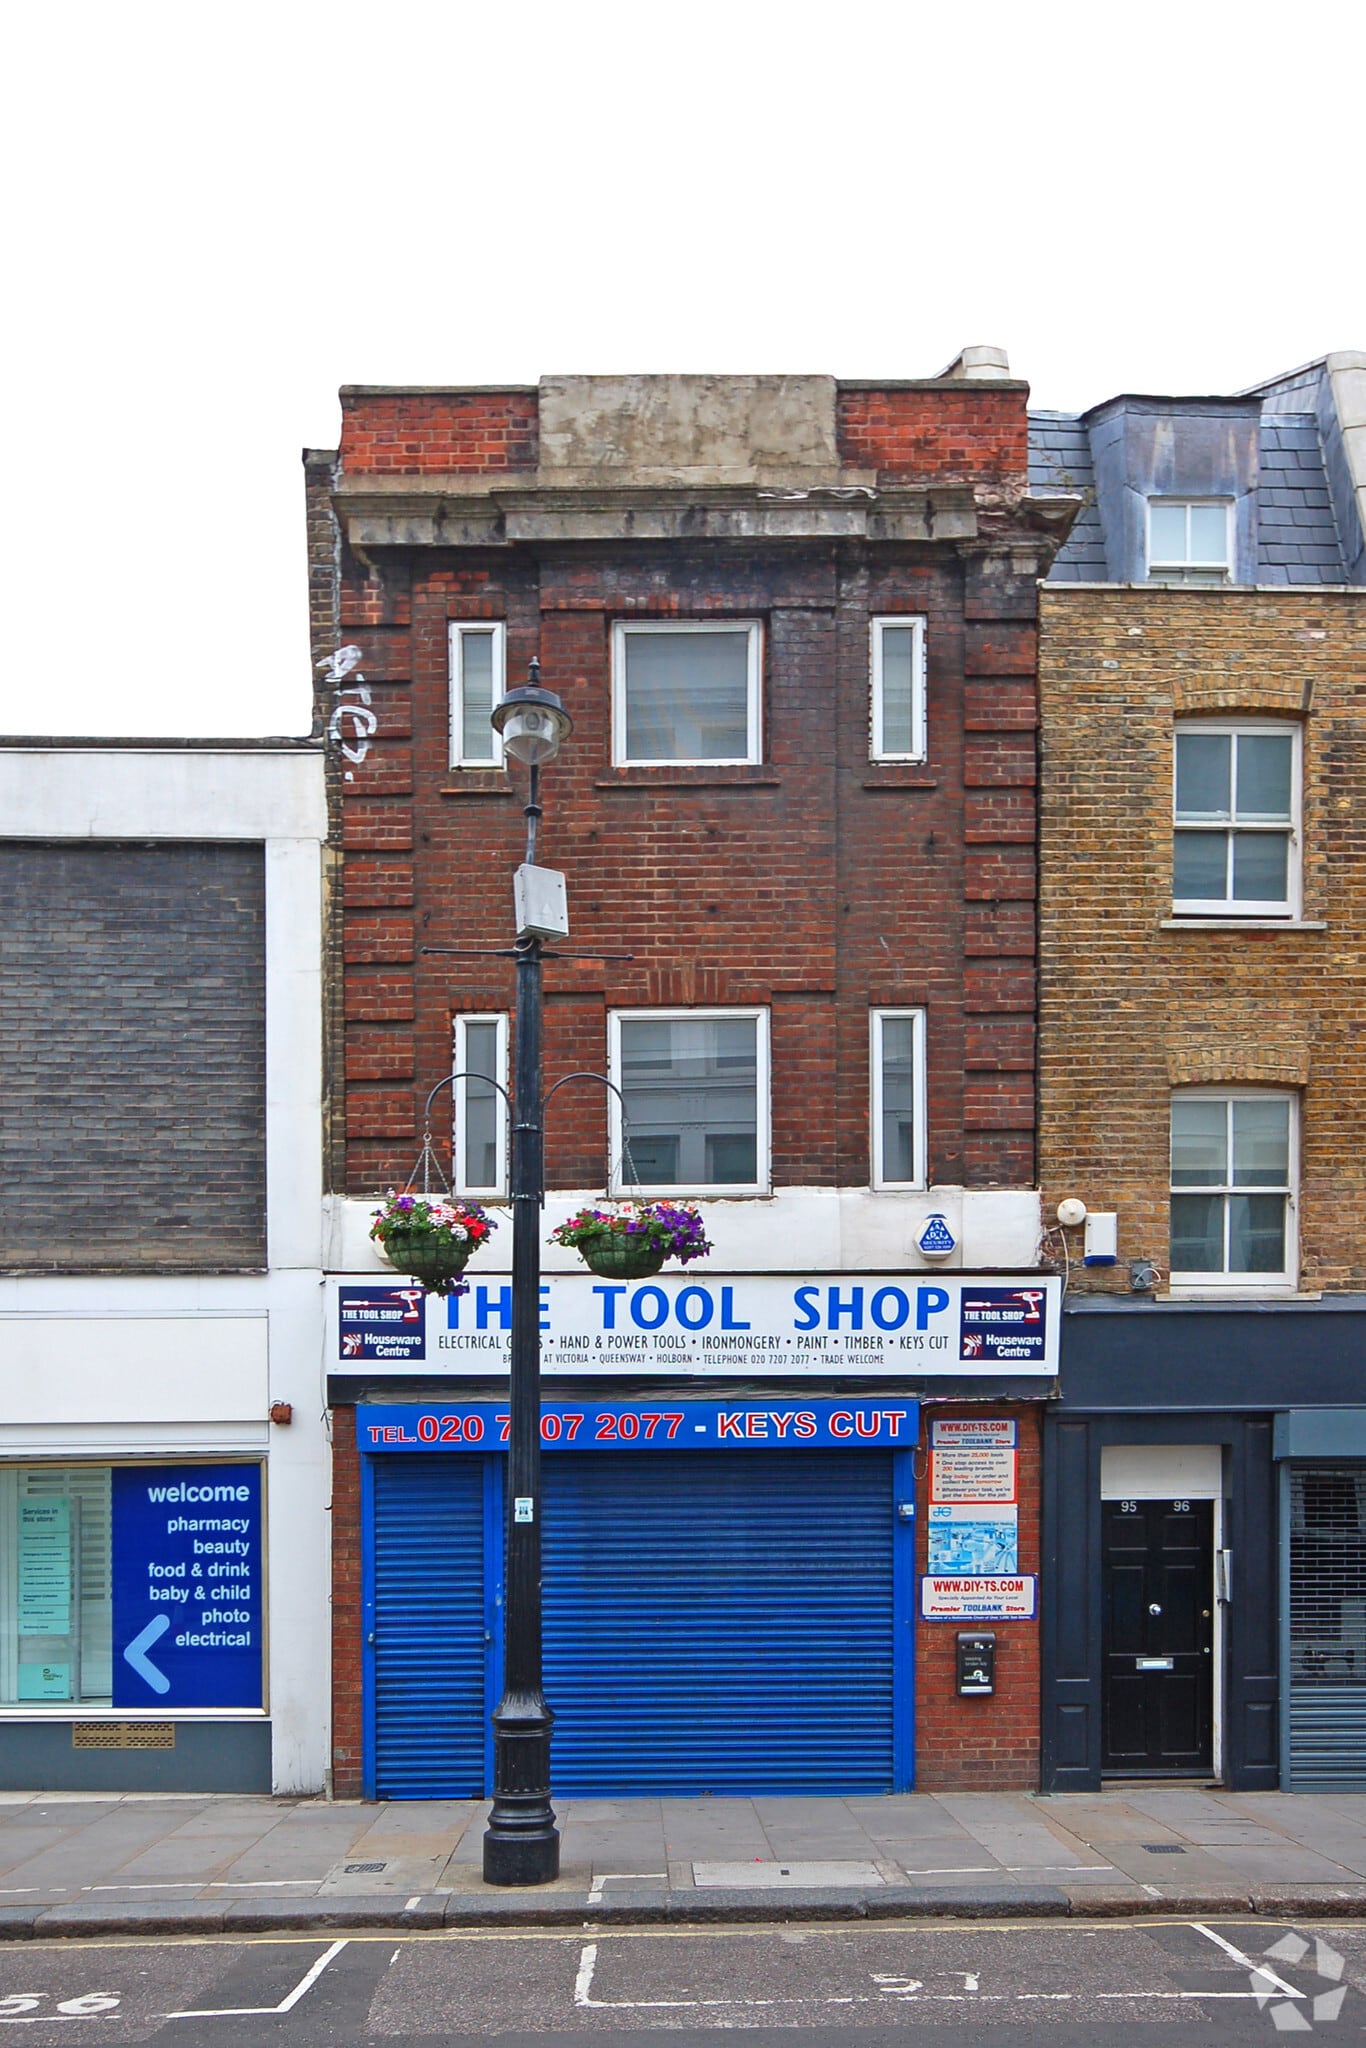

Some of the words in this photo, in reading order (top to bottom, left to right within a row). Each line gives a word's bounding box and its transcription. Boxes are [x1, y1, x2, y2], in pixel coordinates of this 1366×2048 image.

[592, 1285, 751, 1330] TOOL
[794, 1285, 950, 1331] SHOP
[342, 1310, 358, 1319] THE
[360, 1310, 379, 1319] TOOL
[380, 1310, 403, 1320] SHOP
[964, 1311, 980, 1320] THE
[981, 1311, 1000, 1320] TOOL
[1002, 1311, 1025, 1321] SHOP
[364, 1333, 422, 1345] Houseware
[438, 1335, 502, 1349] ELECTRICAL
[560, 1335, 590, 1349] HAND
[595, 1335, 602, 1349] &
[608, 1335, 648, 1349] POWER
[652, 1335, 687, 1349] TOOLS
[702, 1335, 781, 1349] IRONMONGERY
[797, 1336, 828, 1349] PAINT
[844, 1336, 884, 1349] TIMBER
[900, 1336, 924, 1349] KEYS
[929, 1336, 949, 1349] CUT
[986, 1334, 1042, 1345] Houseware
[375, 1345, 410, 1356] Centre
[996, 1346, 1031, 1357] Centre
[544, 1354, 553, 1363] AT
[555, 1354, 588, 1363] VICTORIA
[599, 1354, 646, 1363] QUEENSWAY
[656, 1354, 693, 1363] HOLBORN
[704, 1354, 747, 1364] TELEPHONE
[750, 1354, 766, 1364] 020
[769, 1354, 787, 1364] 7207
[791, 1354, 809, 1364] 2077
[820, 1354, 844, 1364] TRADE
[848, 1354, 884, 1364] WELCOME
[367, 1426, 417, 1443] TEL.
[417, 1415, 484, 1442] 020
[495, 1413, 584, 1441] 707
[595, 1413, 684, 1440] 2077
[717, 1411, 817, 1439] KEYS
[828, 1411, 907, 1438] CUT
[147, 1482, 250, 1503] welcome
[1121, 1501, 1137, 1513] 95
[1173, 1500, 1190, 1512] 96
[167, 1516, 250, 1534] pharmacy
[193, 1539, 250, 1556] beauty
[148, 1562, 185, 1577] food
[191, 1563, 203, 1577] &
[207, 1562, 250, 1577] drink
[933, 1580, 1024, 1592] WWW.DIY-TS.COM
[149, 1586, 189, 1603] baby
[194, 1586, 206, 1600] &
[211, 1585, 250, 1600] child
[202, 1608, 250, 1625] photo
[175, 1631, 250, 1646] electrical
